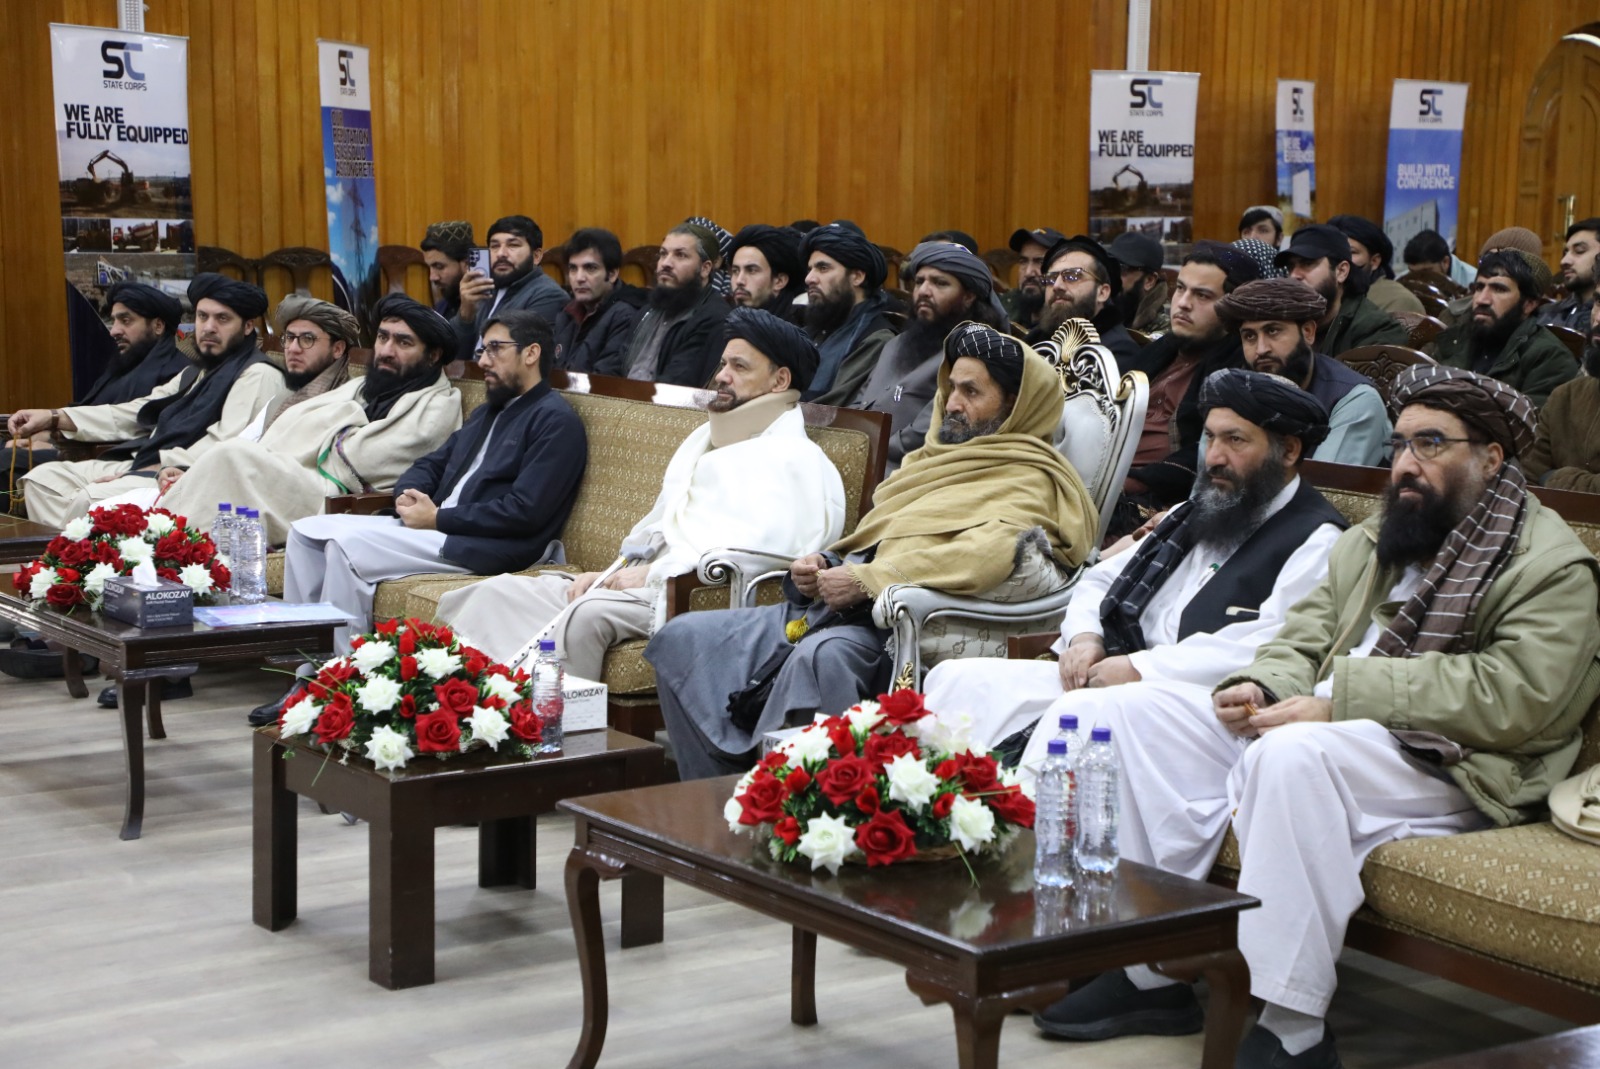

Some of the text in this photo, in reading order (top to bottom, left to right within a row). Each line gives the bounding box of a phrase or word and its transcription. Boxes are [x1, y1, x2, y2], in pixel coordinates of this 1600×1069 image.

[103, 80, 147, 91] STATE CORPS
[64, 103, 124, 124] WE ARE
[66, 121, 189, 145] FULLY EQUIPPED
[1098, 129, 1144, 143] WE ARE
[1098, 143, 1194, 157] FULLY EQUIPPED
[1398, 163, 1450, 177] BUILD WITH
[1397, 176, 1455, 190] CONFIDENCE
[145, 590, 191, 600] ALOKOZAY
